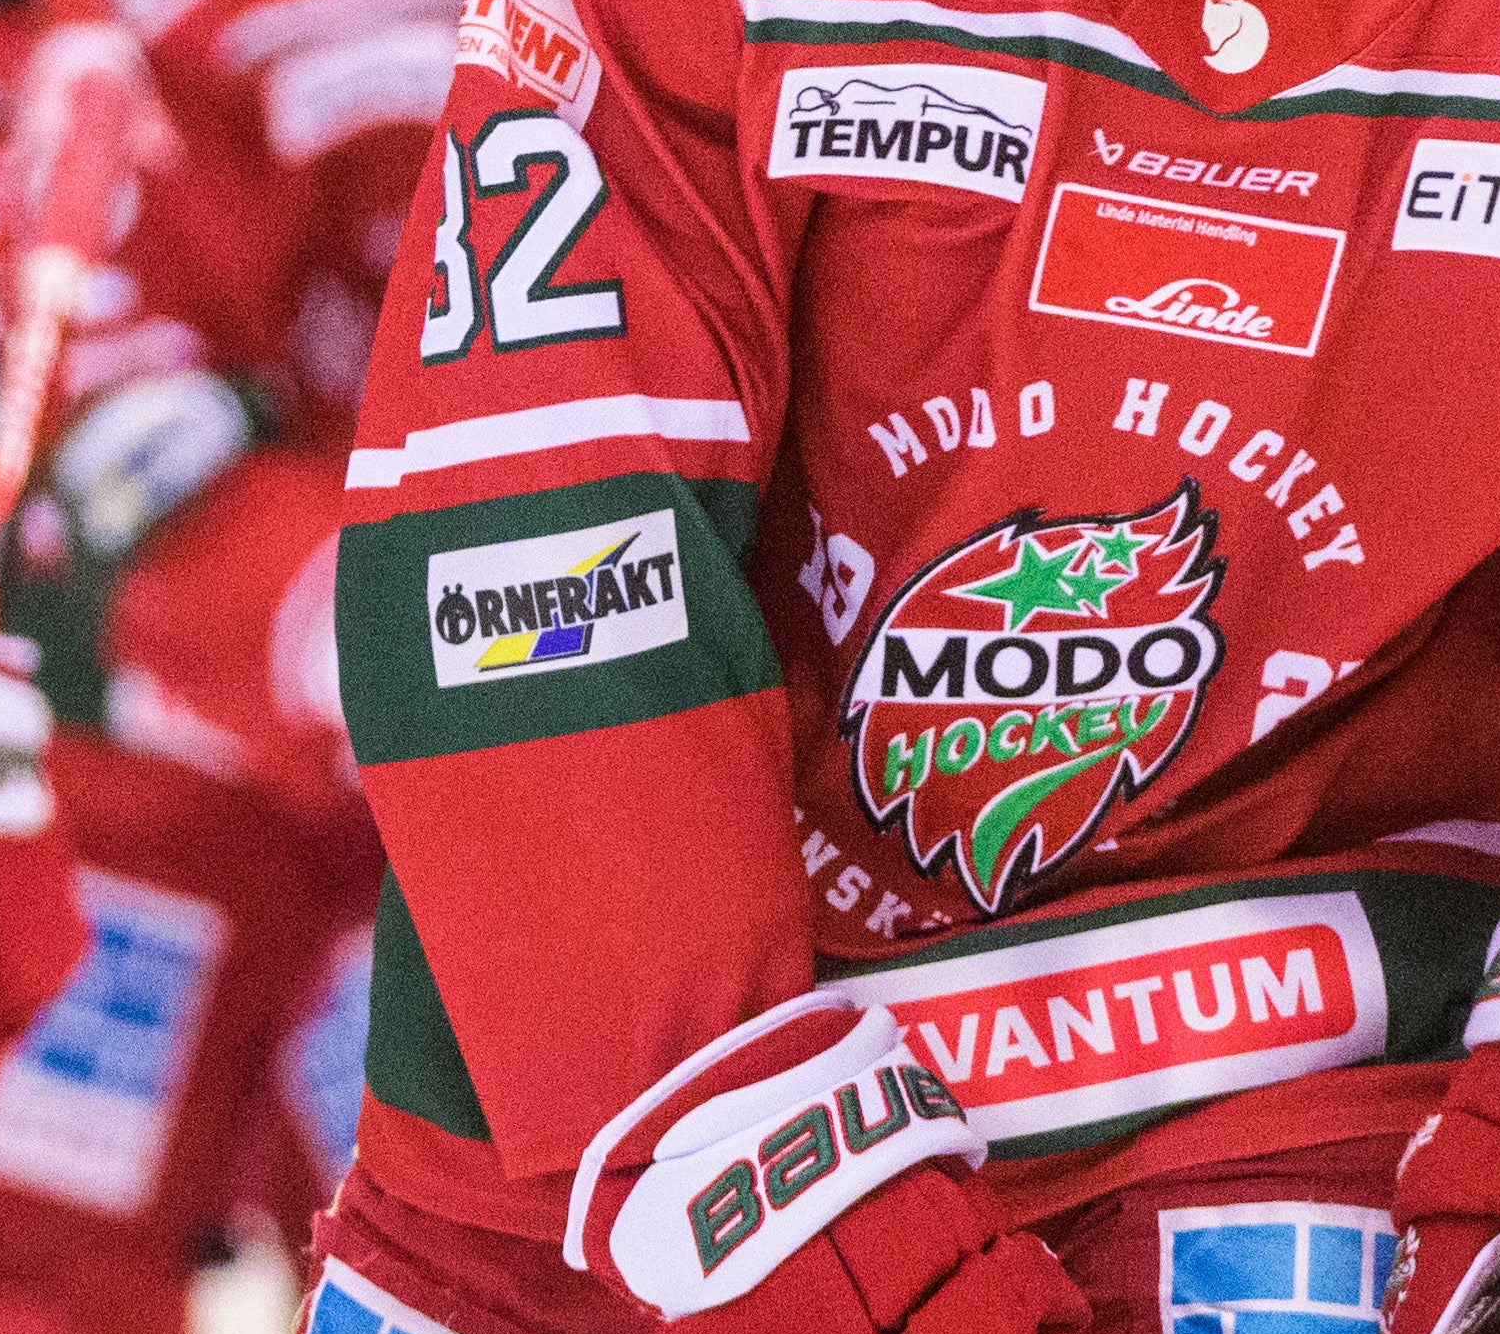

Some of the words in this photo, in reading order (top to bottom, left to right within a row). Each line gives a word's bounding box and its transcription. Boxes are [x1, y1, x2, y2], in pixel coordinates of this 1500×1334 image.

[788, 117, 1031, 186] TEMPUR
[1104, 276, 1275, 340] Linde
[868, 379, 1056, 479] MODO
[1113, 376, 1366, 573] HOCKEY
[878, 623, 1204, 701] MODO
[882, 692, 1172, 795] HOCKEY
